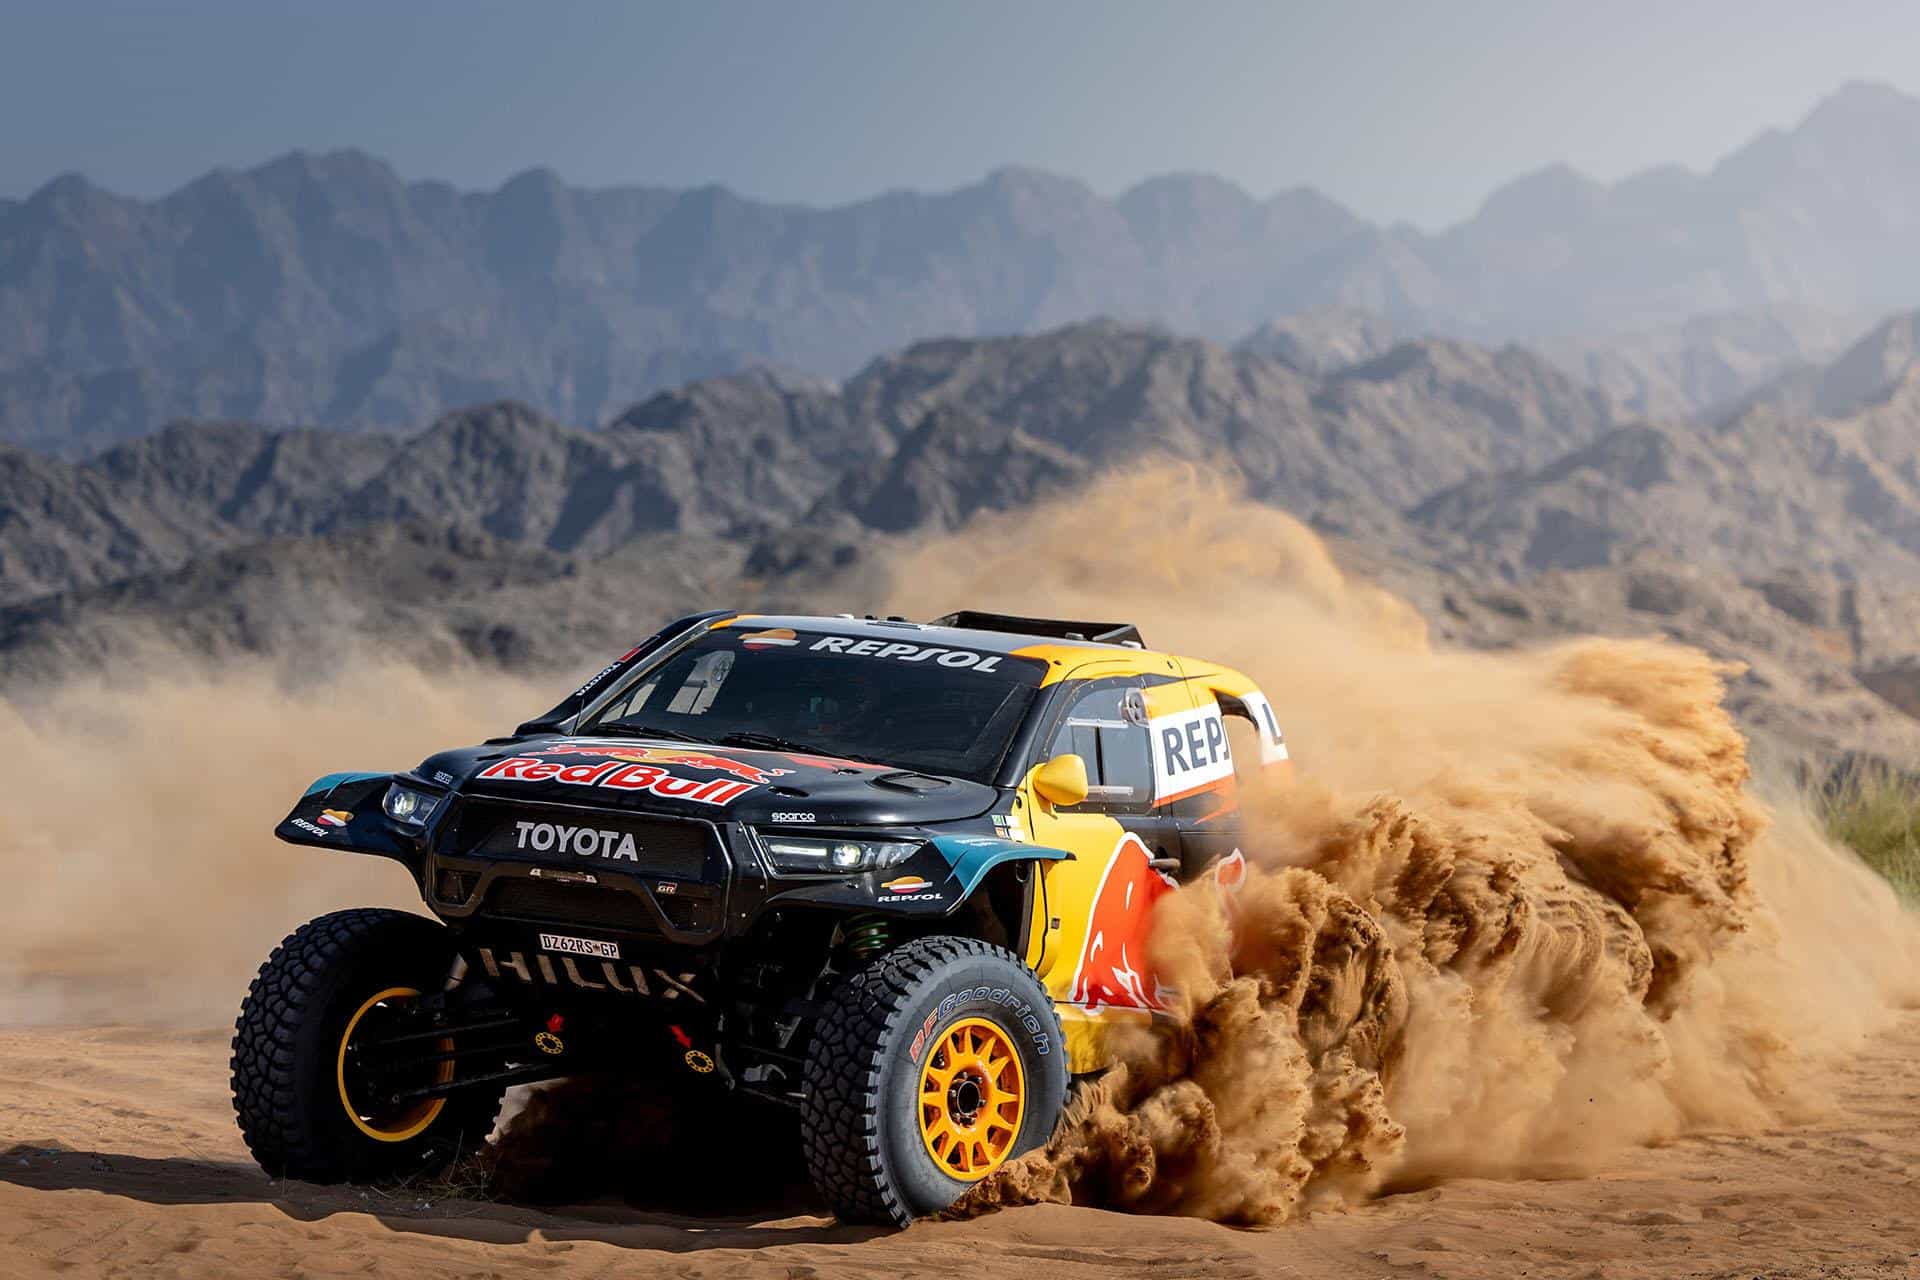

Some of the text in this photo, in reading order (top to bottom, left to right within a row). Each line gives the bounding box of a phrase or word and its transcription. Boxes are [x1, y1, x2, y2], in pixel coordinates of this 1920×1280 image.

[809, 636, 1002, 673] REPSOL
[1162, 703, 1284, 776] REPL
[478, 757, 758, 805] Red Bull
[291, 818, 328, 838] REPSOL
[771, 812, 816, 823] sparco
[516, 821, 639, 862] TOYOTA
[656, 883, 676, 895] GR
[877, 892, 944, 903] REPSOL
[542, 936, 617, 957] DZ62RS GP
[479, 948, 705, 1002] HILUX
[909, 987, 1050, 1064] BFGoodrich
